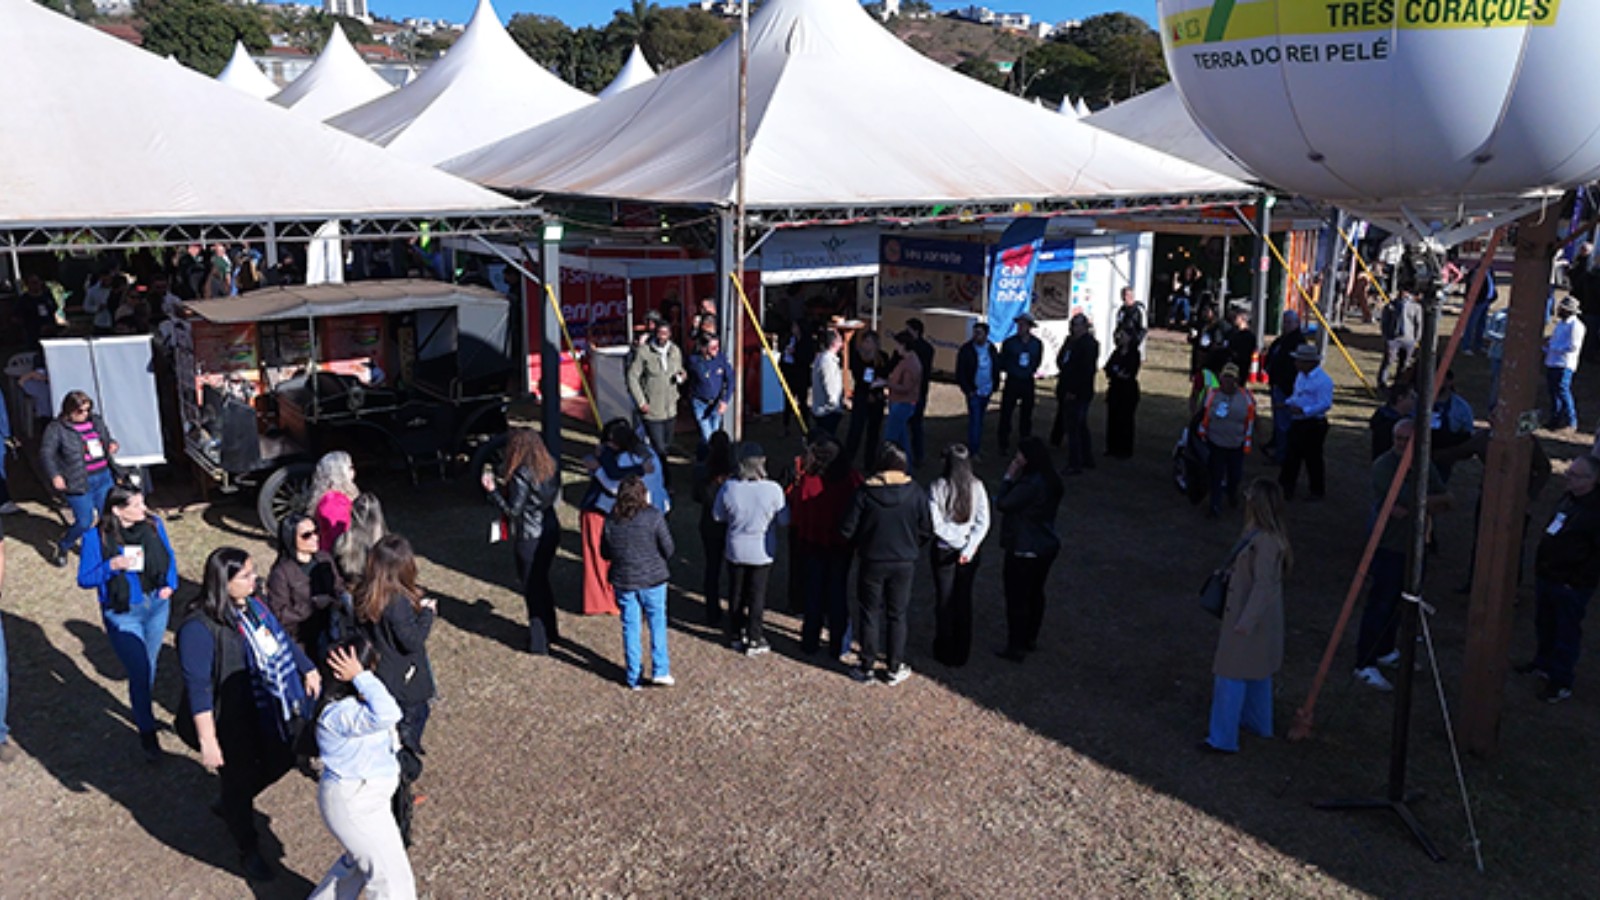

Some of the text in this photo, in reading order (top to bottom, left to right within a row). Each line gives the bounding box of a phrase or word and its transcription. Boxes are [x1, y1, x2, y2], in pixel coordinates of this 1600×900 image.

[1193, 36, 1389, 70] TERRA DO REI PELÉ
[562, 299, 626, 327] empre
